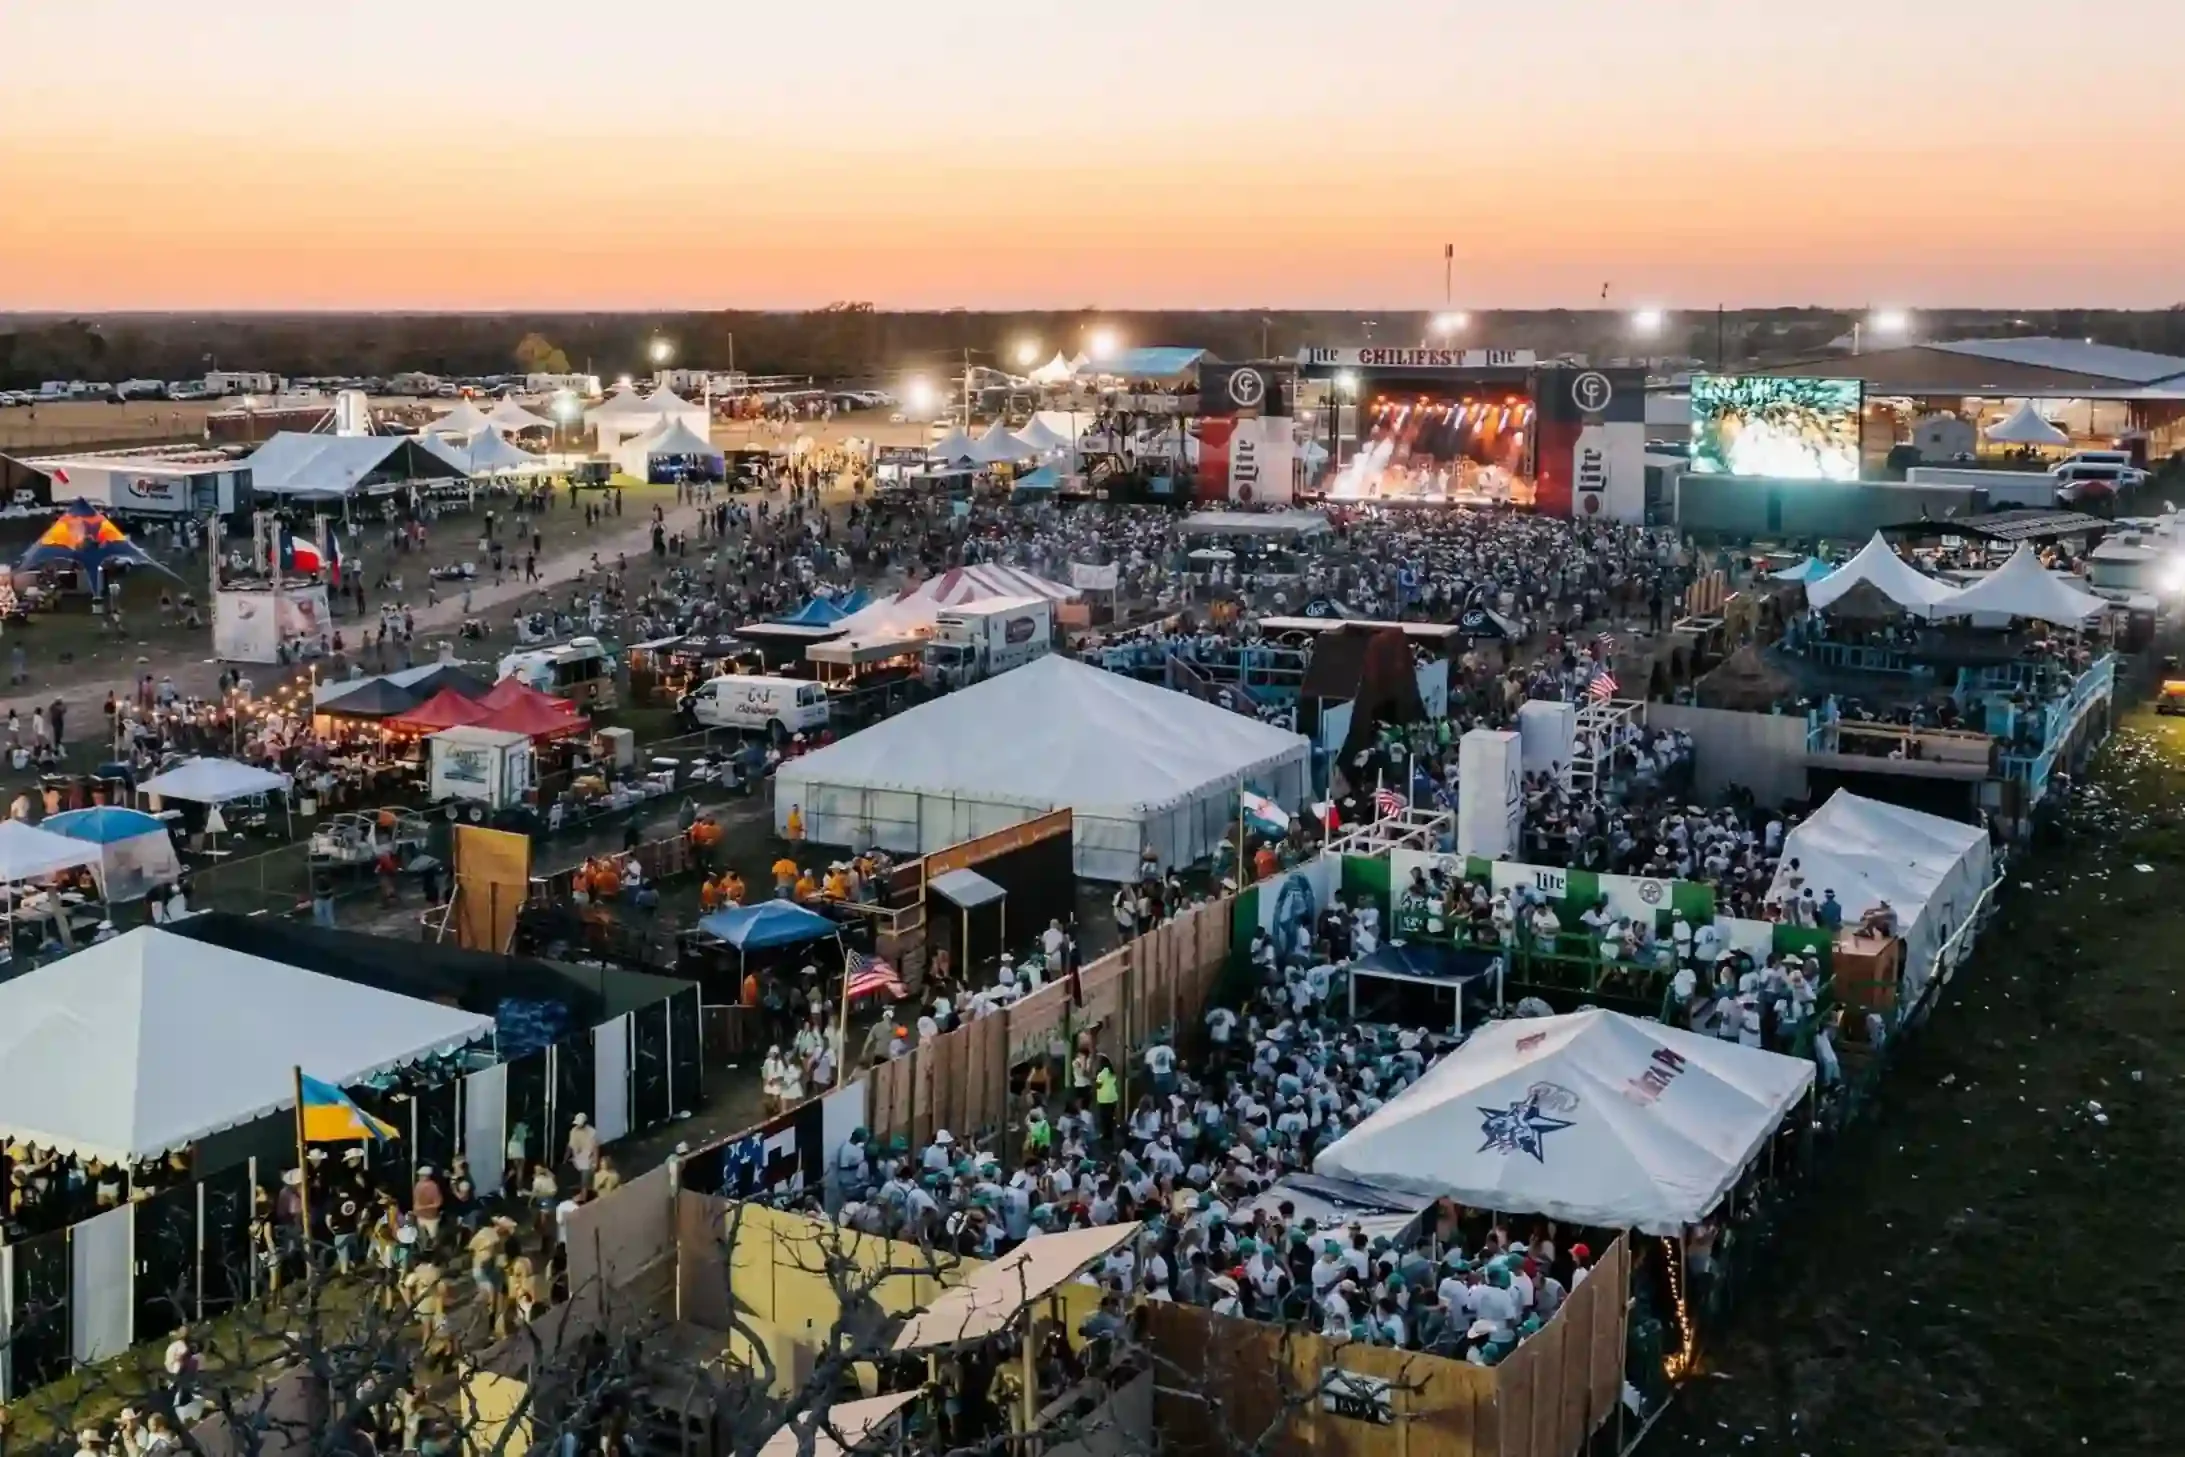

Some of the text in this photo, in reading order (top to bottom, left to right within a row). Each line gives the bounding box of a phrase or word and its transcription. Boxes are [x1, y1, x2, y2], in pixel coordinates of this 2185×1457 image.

[1358, 348, 1467, 365] CHILIFEST
[1234, 439, 1260, 481] Lite
[1578, 447, 1607, 492] Lite
[1536, 871, 1565, 892] Lite
